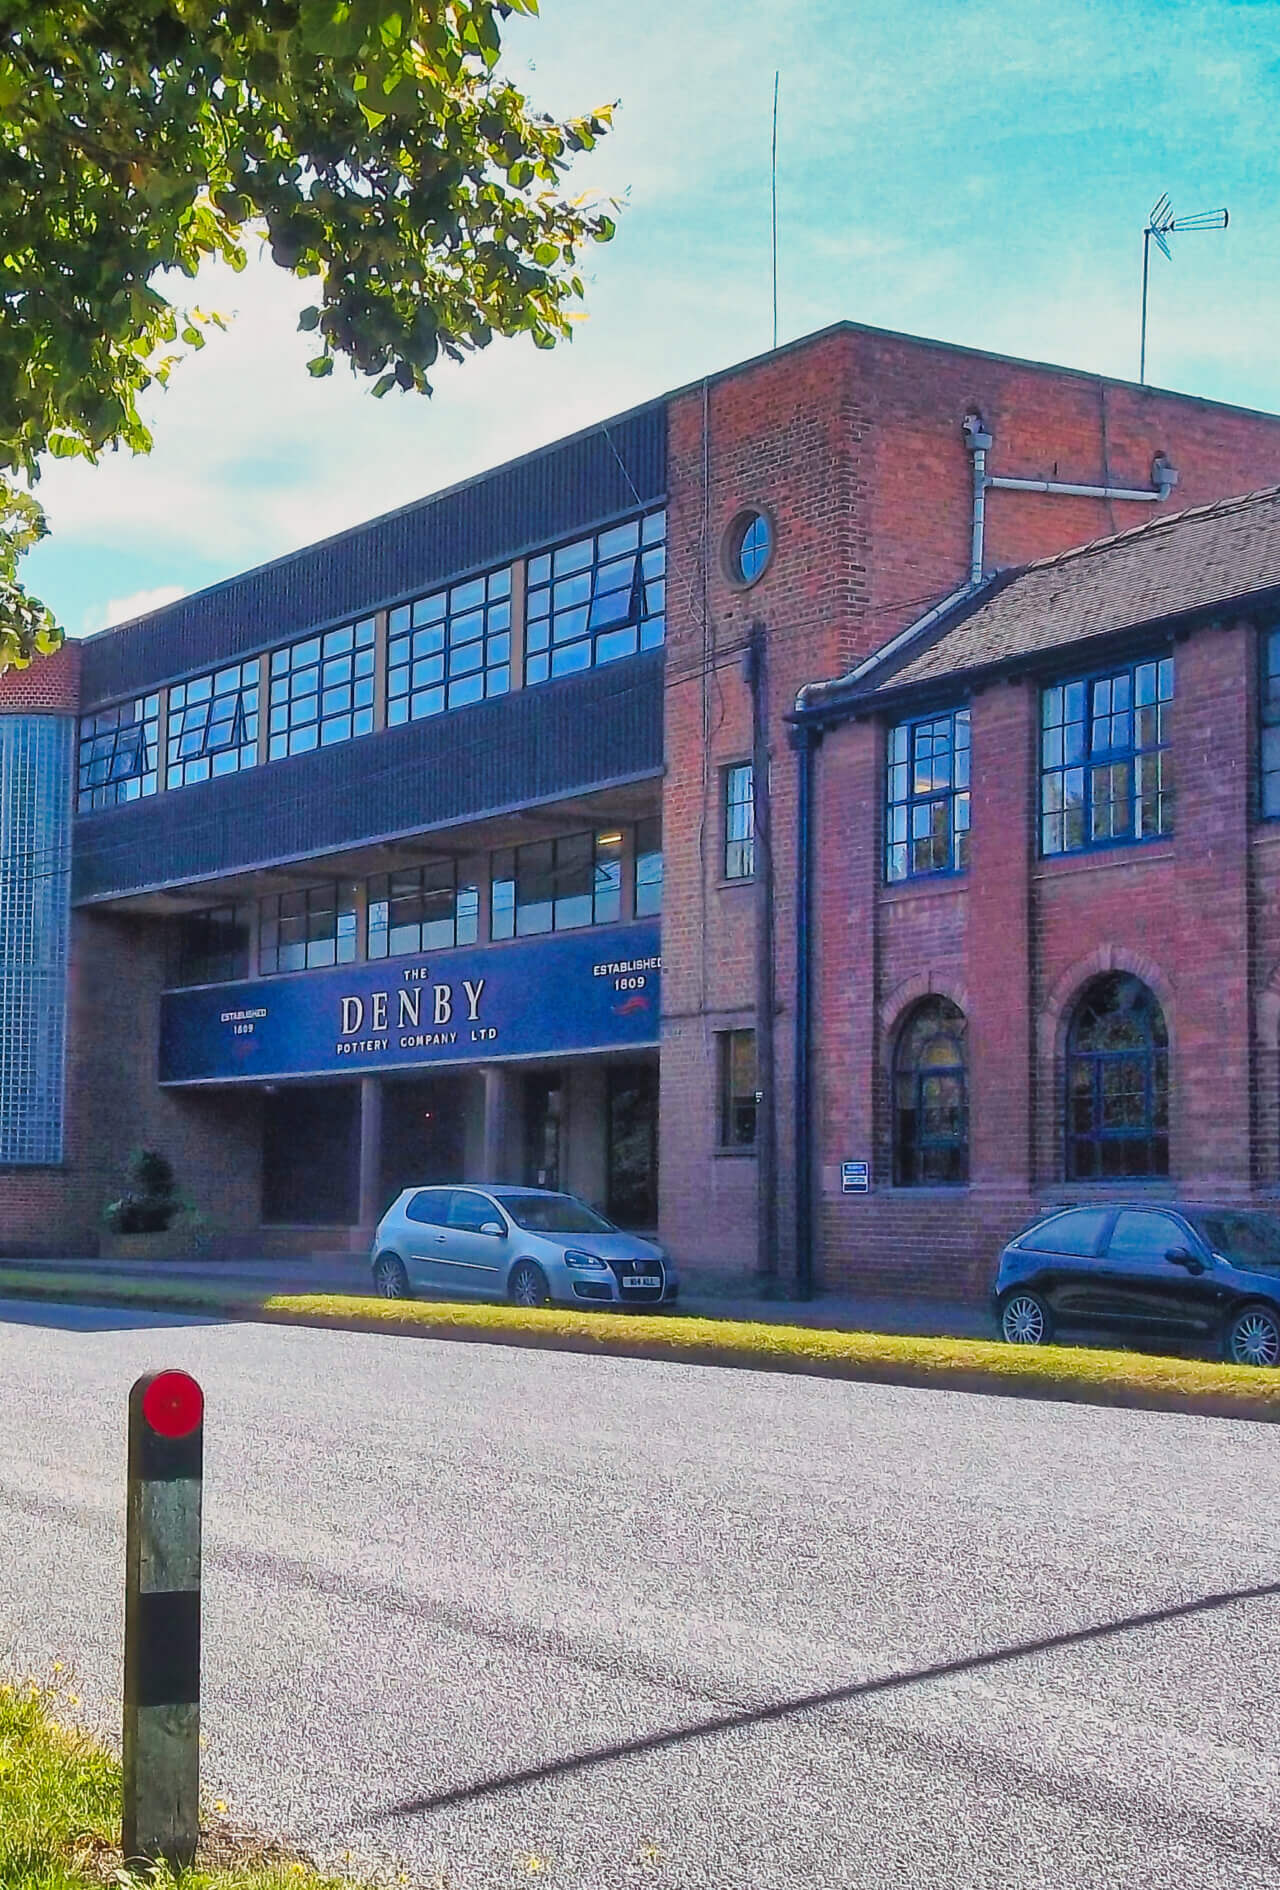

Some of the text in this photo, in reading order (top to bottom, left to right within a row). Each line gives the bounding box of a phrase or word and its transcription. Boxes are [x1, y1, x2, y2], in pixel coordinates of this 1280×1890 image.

[404, 968, 428, 981] THE
[615, 976, 645, 991] 1809
[340, 979, 485, 1035] DENBY
[336, 1028, 497, 1055] POTTERY COMPANY LTD
